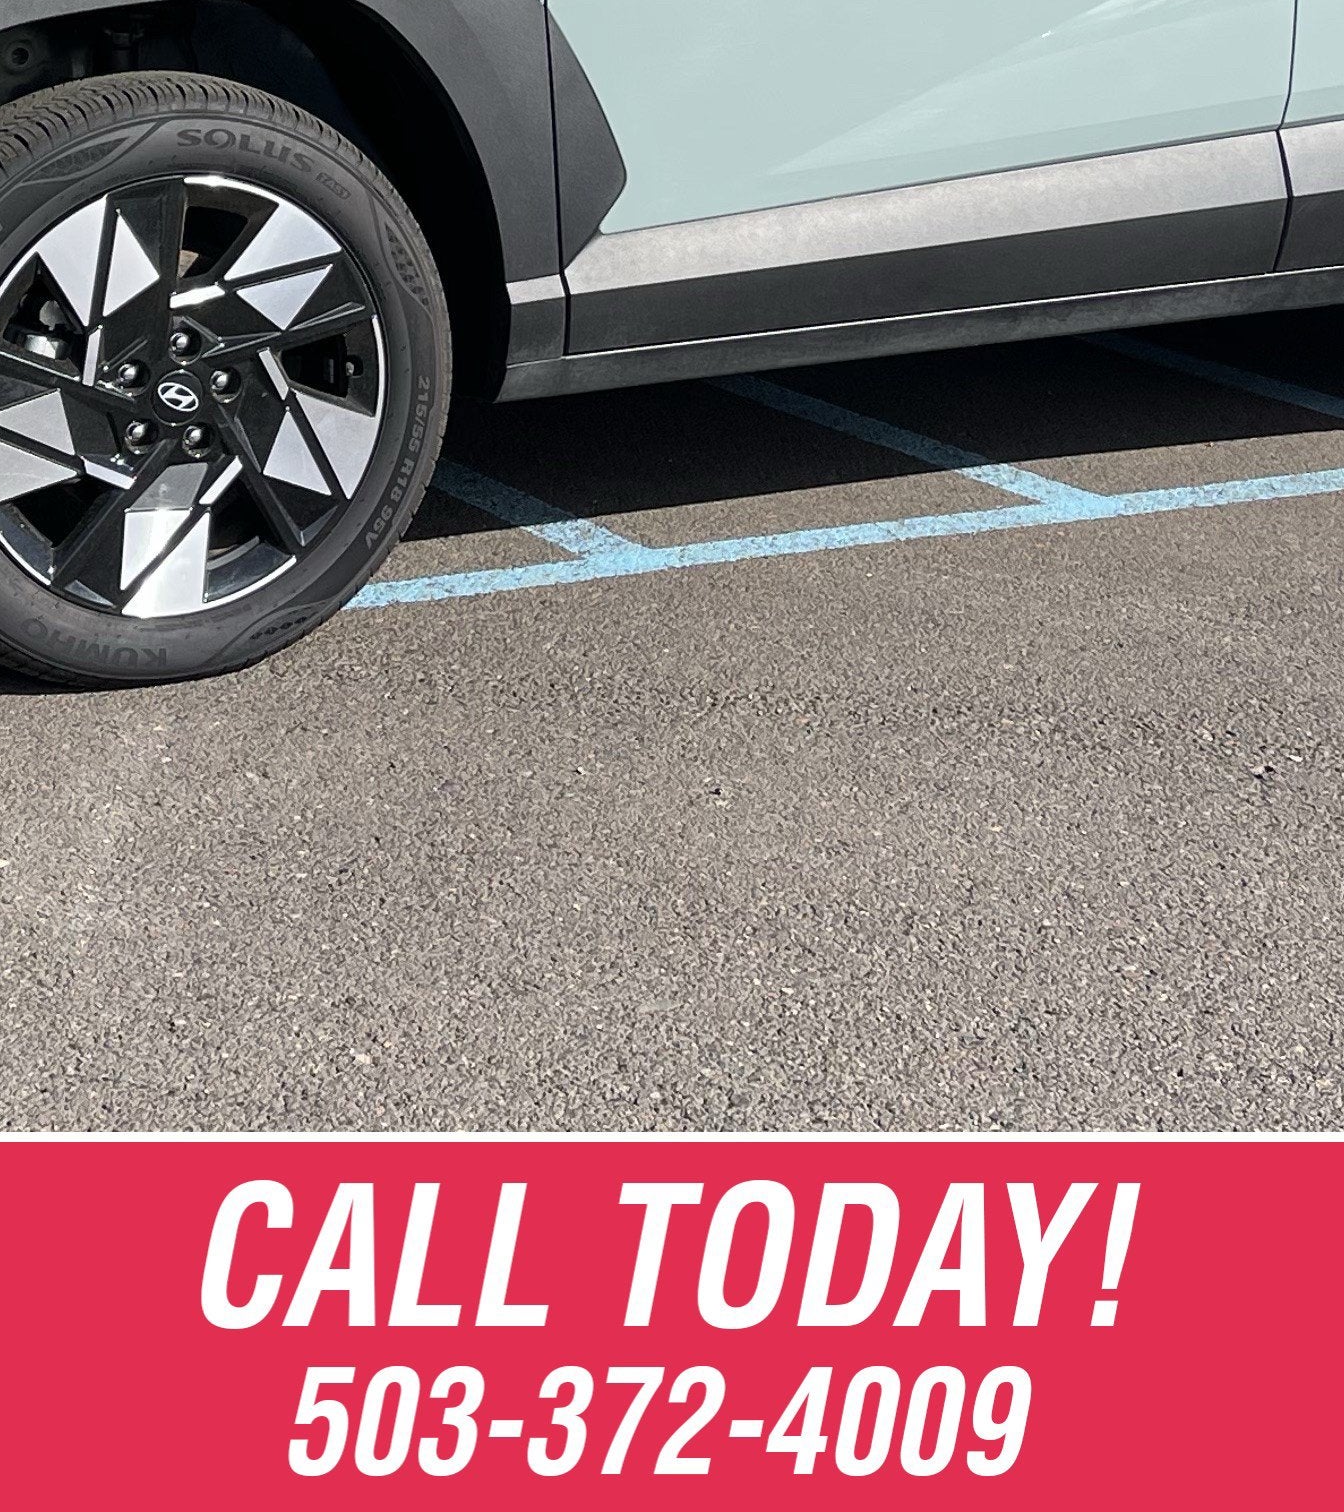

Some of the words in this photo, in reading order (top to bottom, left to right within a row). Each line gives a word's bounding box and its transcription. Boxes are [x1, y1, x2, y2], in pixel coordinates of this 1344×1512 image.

[176, 129, 315, 173] SOLUS
[408, 375, 431, 454] 215/55
[390, 458, 415, 502] R18
[19, 618, 167, 668] KUMHO
